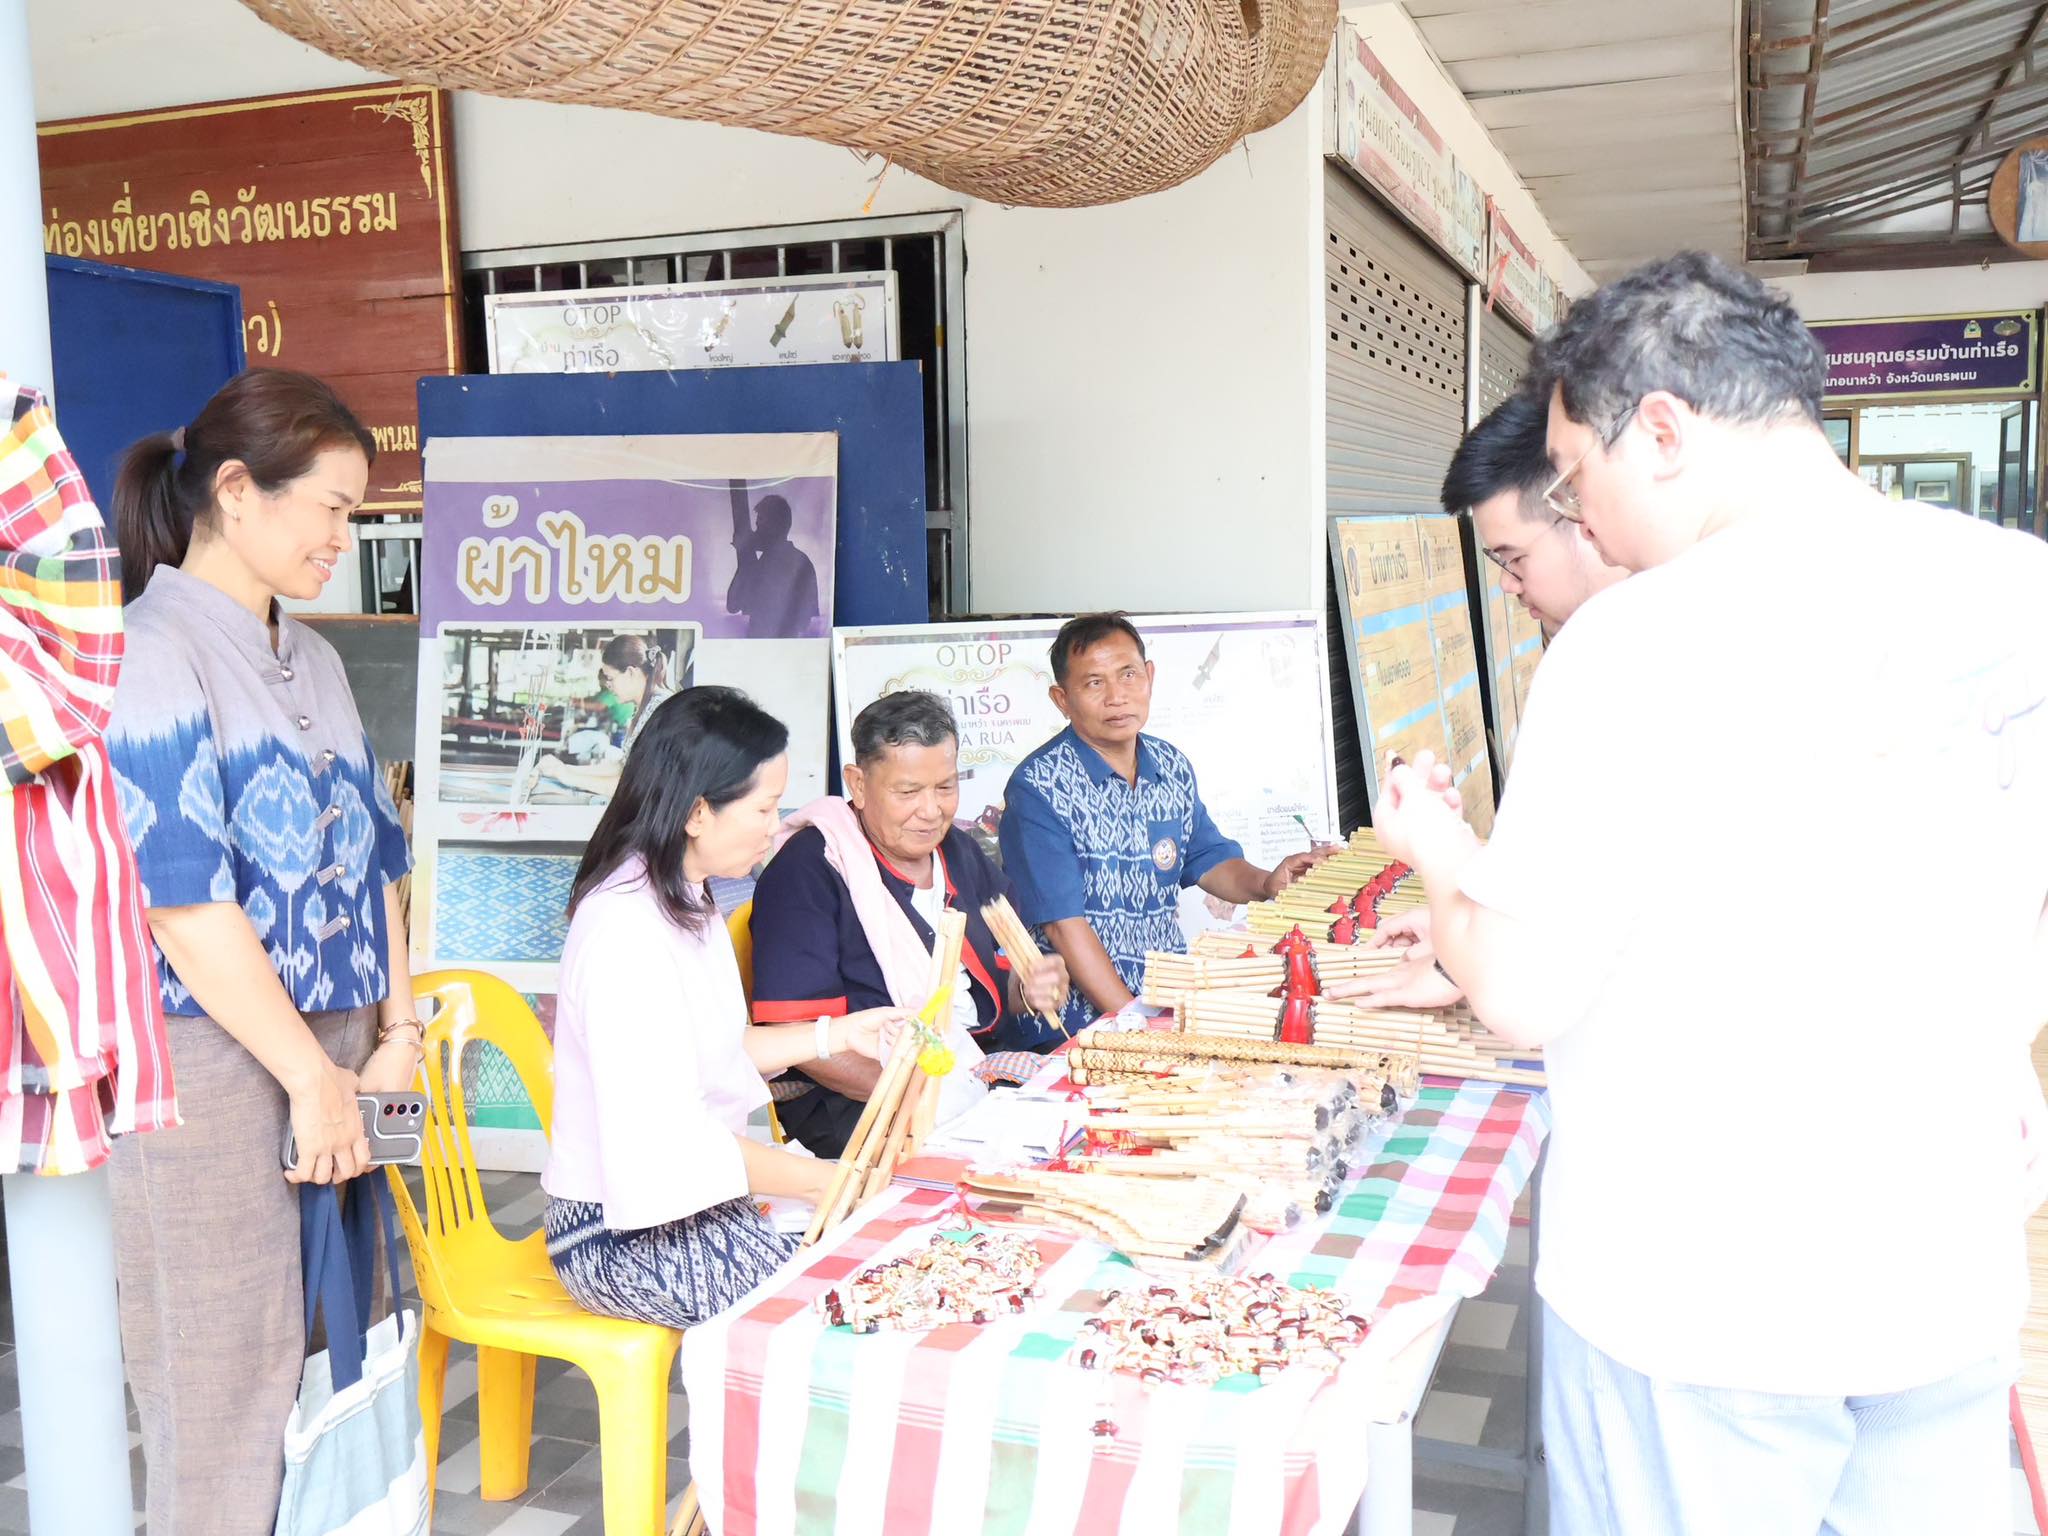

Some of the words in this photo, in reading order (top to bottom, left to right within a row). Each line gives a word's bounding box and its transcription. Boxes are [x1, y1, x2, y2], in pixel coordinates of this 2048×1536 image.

[563, 304, 621, 327] OTOP
[462, 500, 687, 599] ผ้าไหม
[937, 643, 1012, 667] OTOP
[980, 731, 1015, 745] RUA
